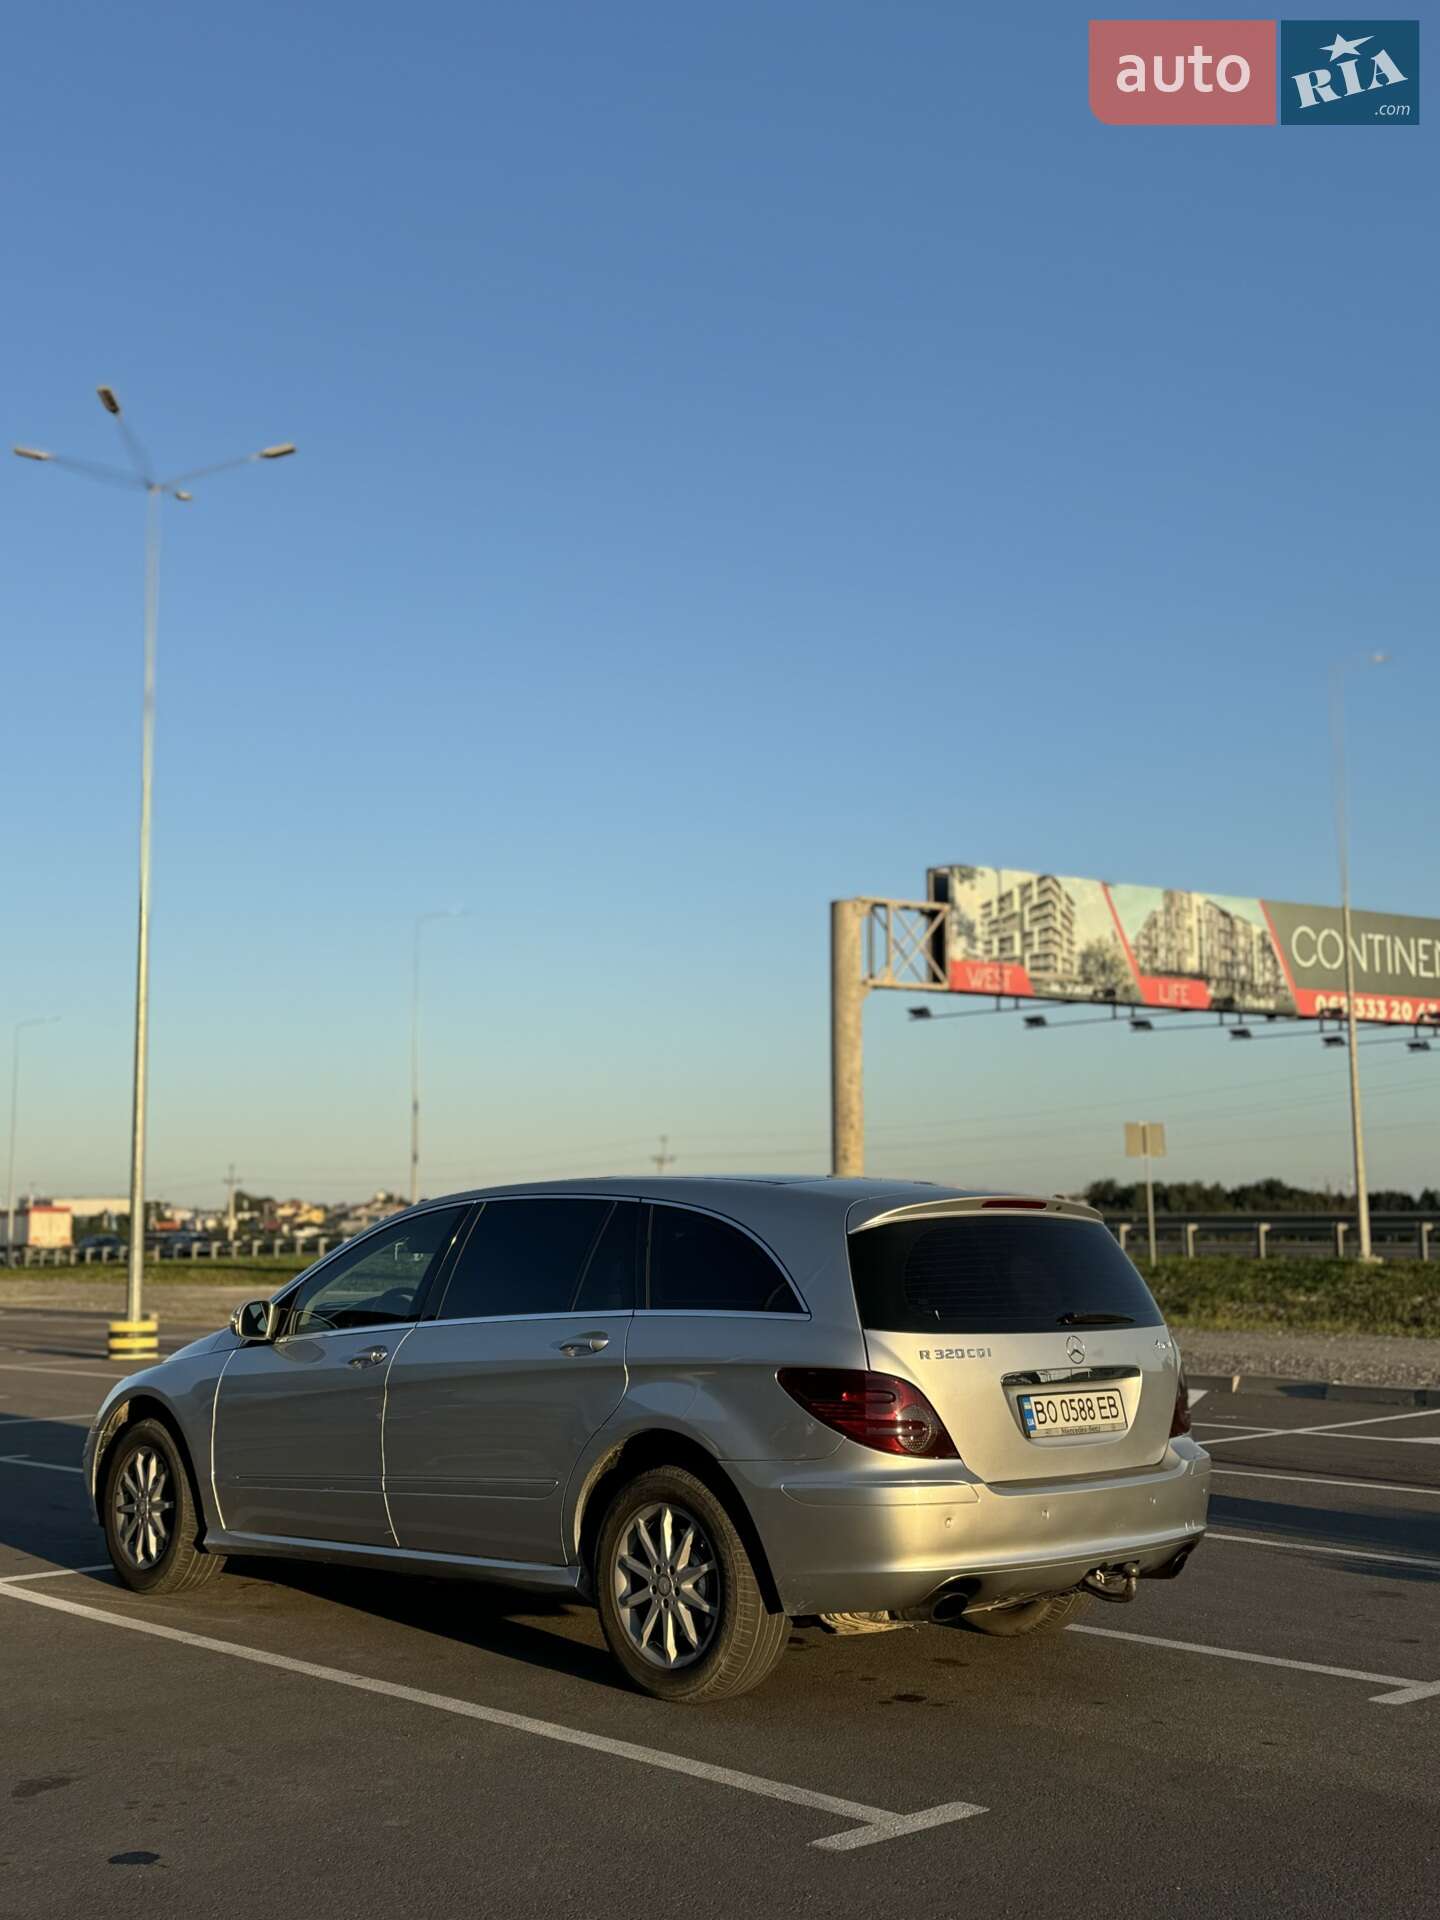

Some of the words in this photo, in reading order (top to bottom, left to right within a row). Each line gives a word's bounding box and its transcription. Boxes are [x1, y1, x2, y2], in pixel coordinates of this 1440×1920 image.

[1291, 925, 1440, 978] CONTINE
[966, 967, 1012, 991] WEST
[1158, 983, 1190, 1003] LIFE
[1355, 998, 1388, 1020] 333
[1391, 1000, 1413, 1022] 20
[918, 1349, 931, 1360] R
[1033, 1400, 1058, 1424] BO
[1060, 1398, 1096, 1422] 0588
[1096, 1395, 1119, 1419] EB
